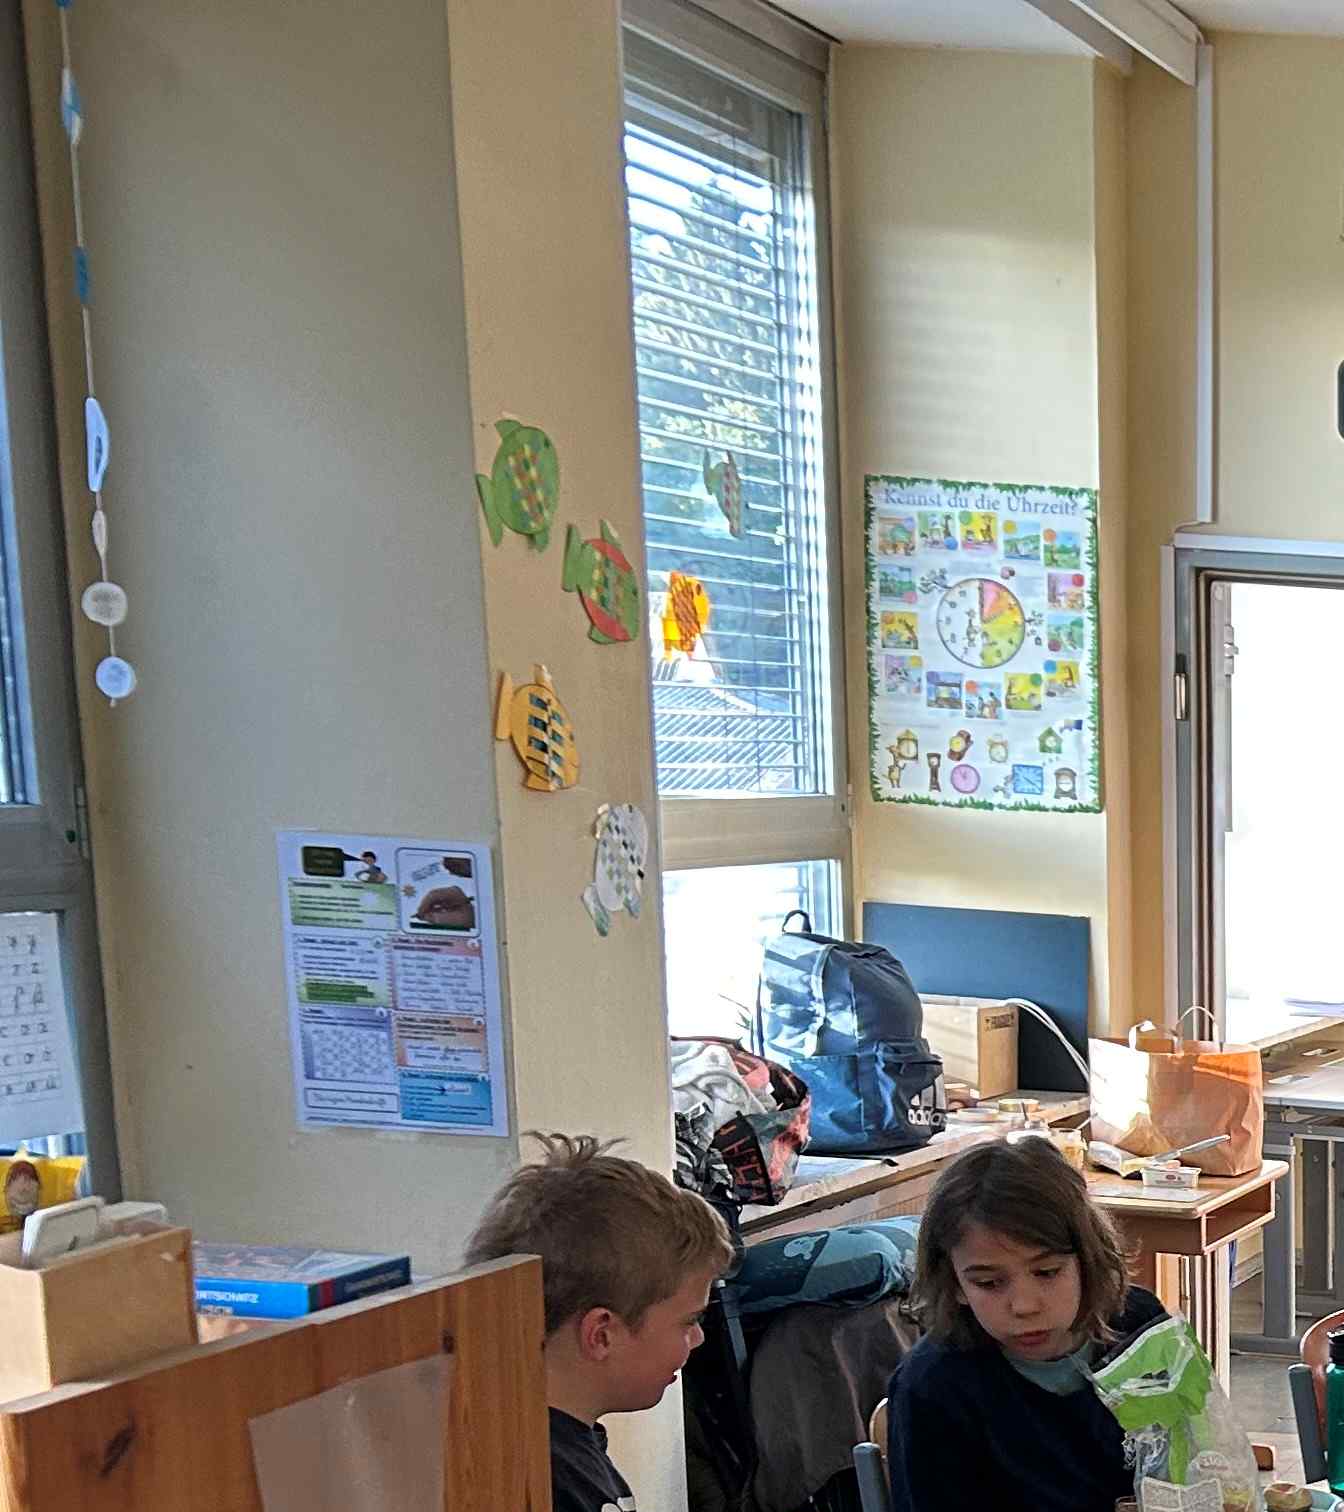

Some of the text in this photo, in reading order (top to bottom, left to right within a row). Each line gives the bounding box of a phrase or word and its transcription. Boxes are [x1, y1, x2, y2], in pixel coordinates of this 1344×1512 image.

[884, 489, 1079, 516] Kennst du die Uhrzeit?
